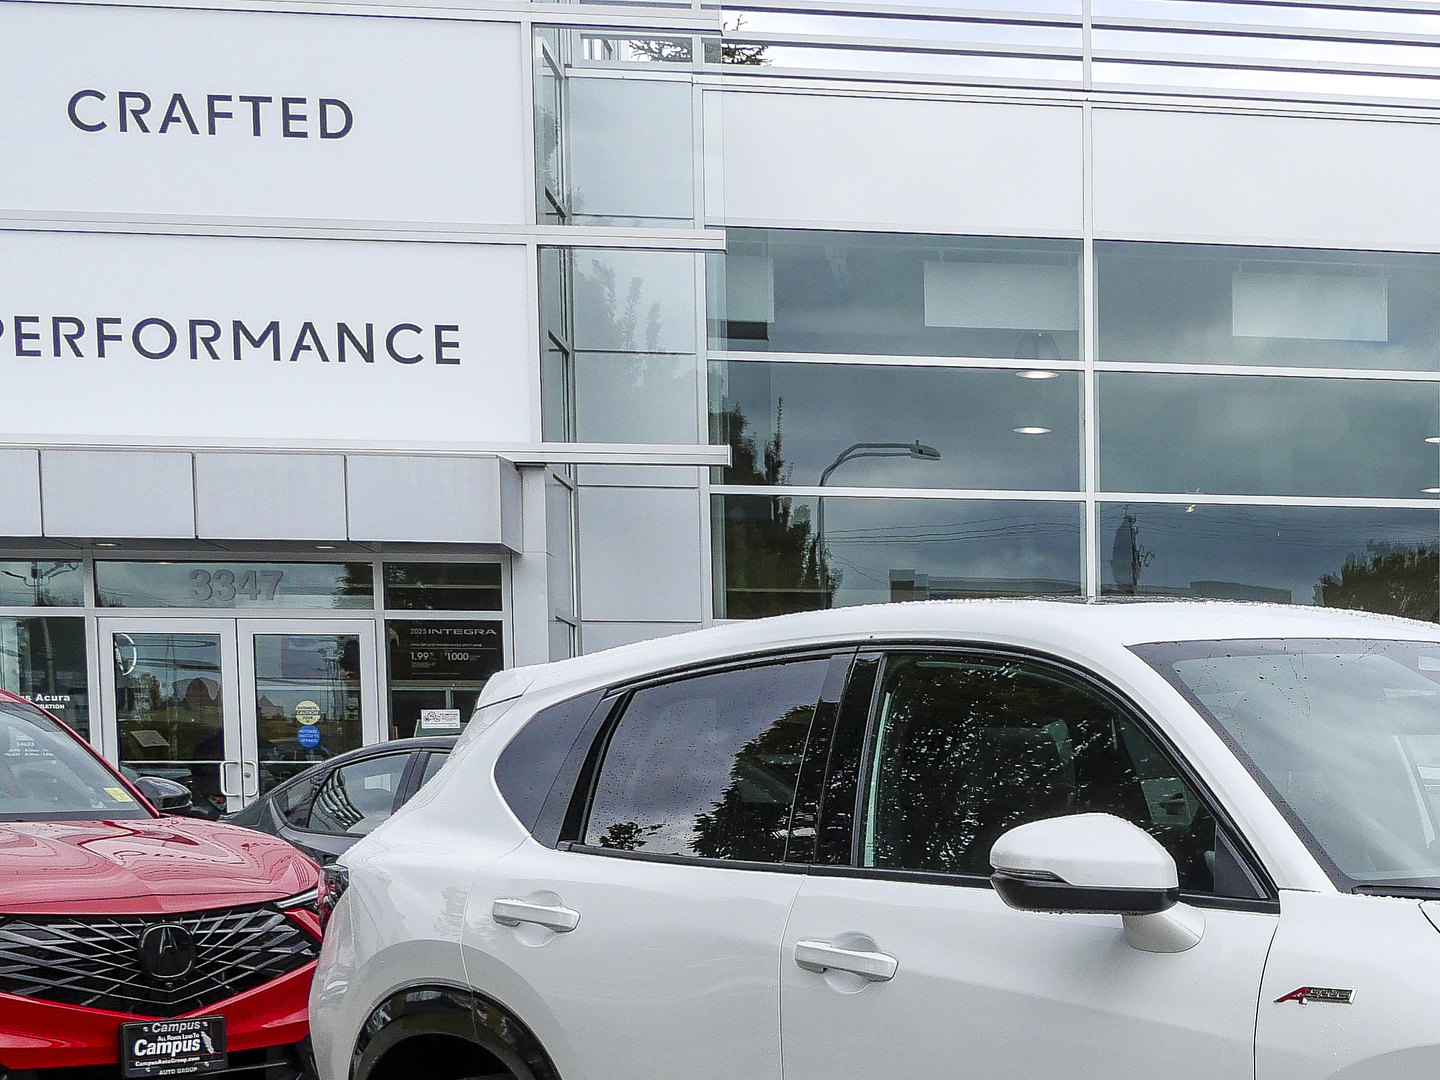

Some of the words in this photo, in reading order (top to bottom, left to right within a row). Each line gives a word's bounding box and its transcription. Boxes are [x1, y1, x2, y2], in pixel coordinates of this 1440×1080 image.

[67, 89, 353, 139] CRAFTED
[0, 315, 461, 365] ERFORMANCE
[190, 569, 284, 601] 3347
[35, 693, 71, 702] Acura
[152, 1021, 201, 1033] Campus
[134, 1038, 201, 1057] Campus
